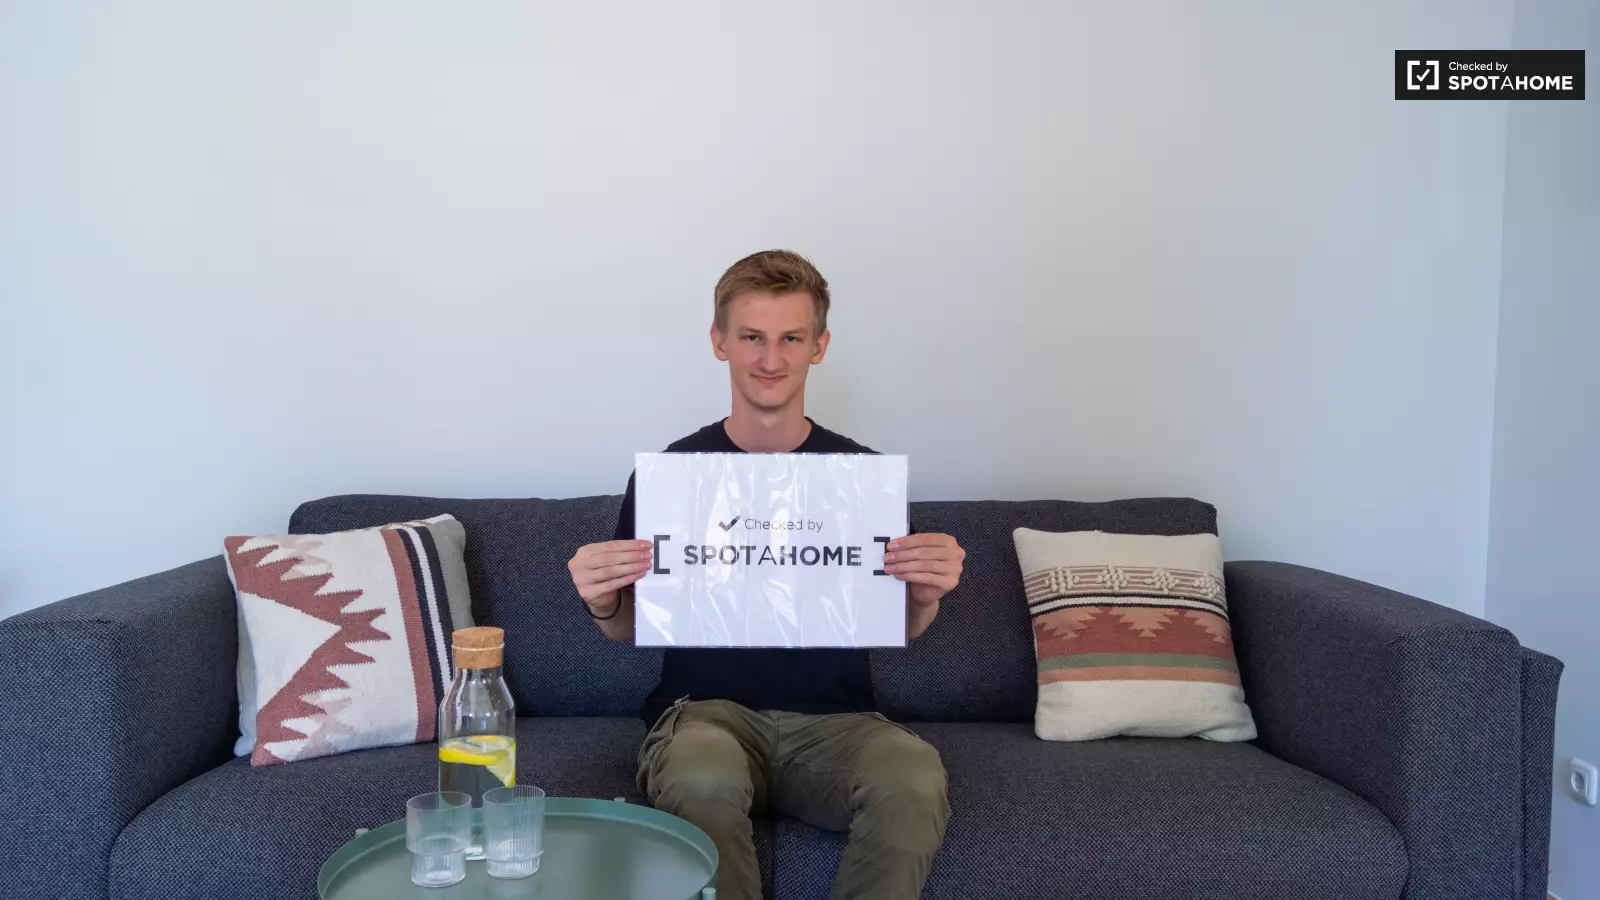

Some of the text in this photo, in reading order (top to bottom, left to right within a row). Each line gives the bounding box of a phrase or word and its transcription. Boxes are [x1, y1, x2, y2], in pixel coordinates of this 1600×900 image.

[744, 517, 824, 533] Checked by
[683, 544, 862, 567] SPOTAHOME
